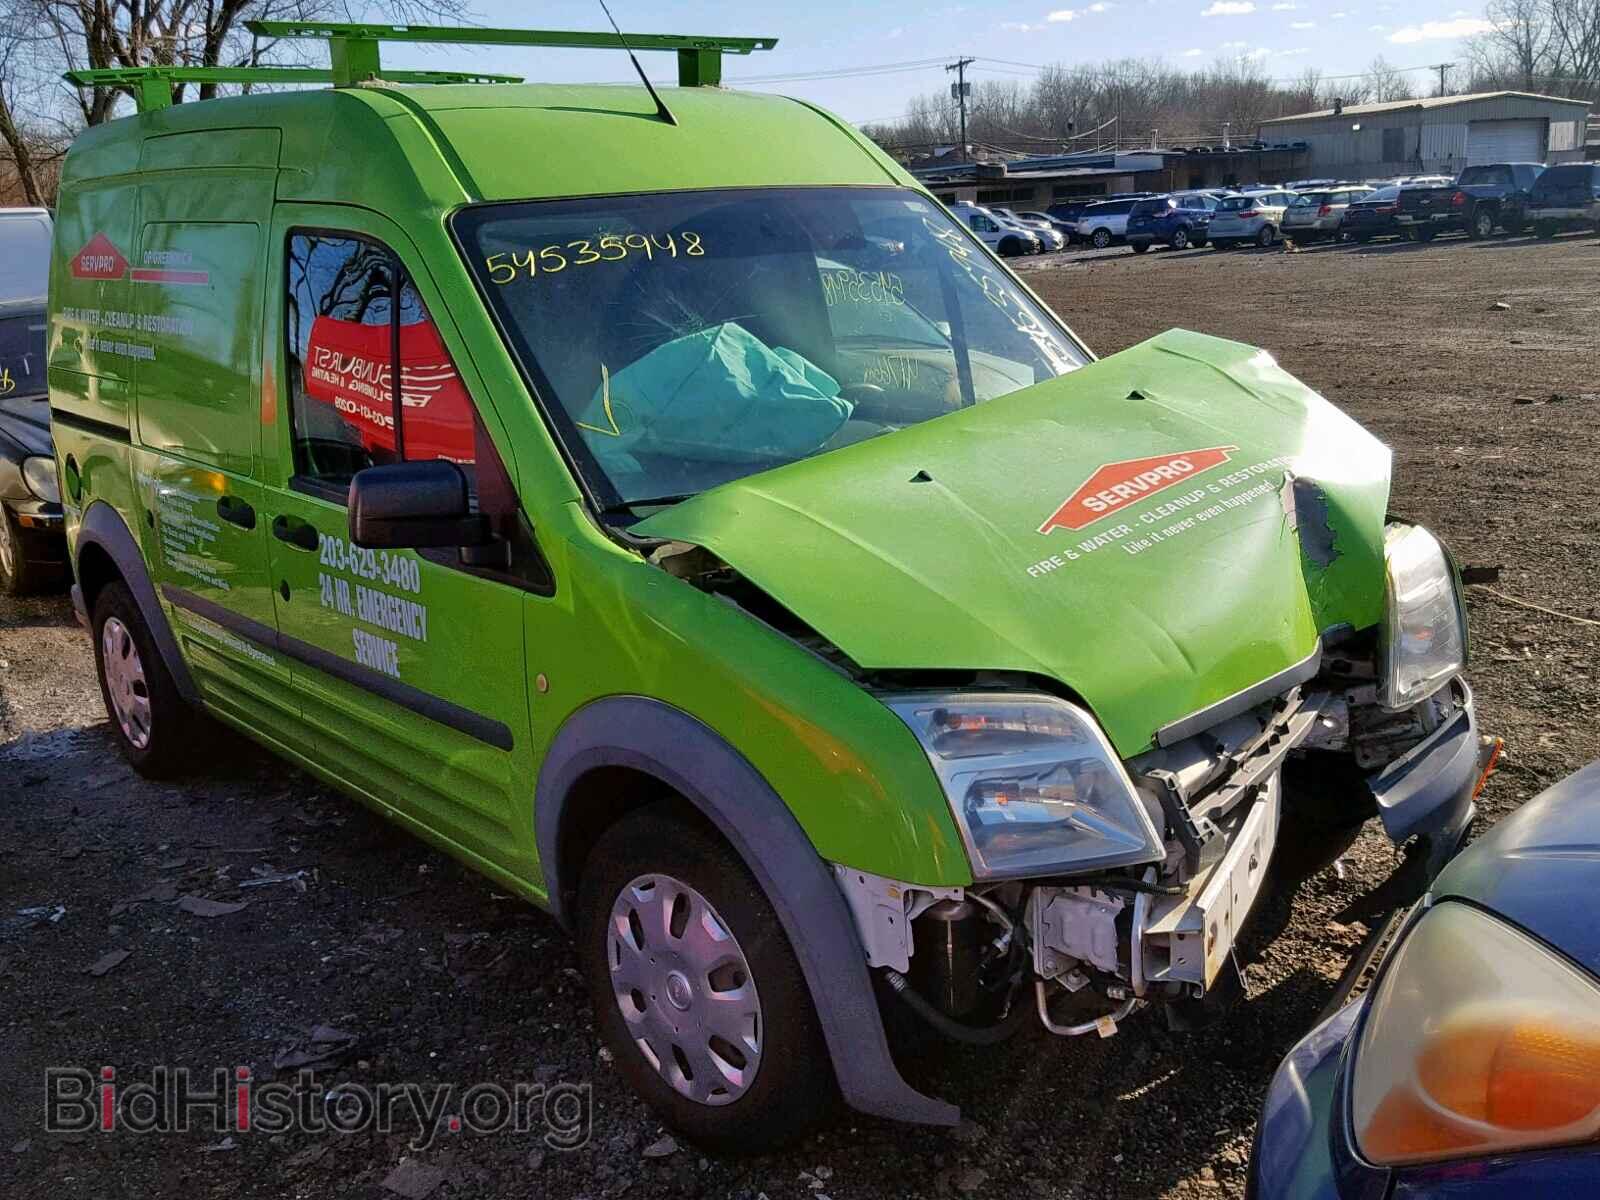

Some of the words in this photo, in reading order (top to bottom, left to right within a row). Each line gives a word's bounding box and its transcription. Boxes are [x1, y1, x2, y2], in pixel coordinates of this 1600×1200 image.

[80, 255, 114, 273] SERVPRO
[486, 231, 705, 285] 54535948
[1081, 458, 1195, 513] SERVPRO
[1026, 555, 1065, 579] FIRE
[1066, 548, 1080, 561] &
[1078, 523, 1133, 554] WATER
[1140, 489, 1206, 525] CLEANUP
[1206, 483, 1222, 494] &
[1123, 535, 1152, 555] Like
[1164, 516, 1195, 537] never
[1196, 504, 1225, 522] even
[319, 533, 421, 594] 203-629-3480
[320, 572, 335, 609] 24
[356, 584, 428, 642] EMERGENCY
[352, 628, 401, 679] SERVICE
